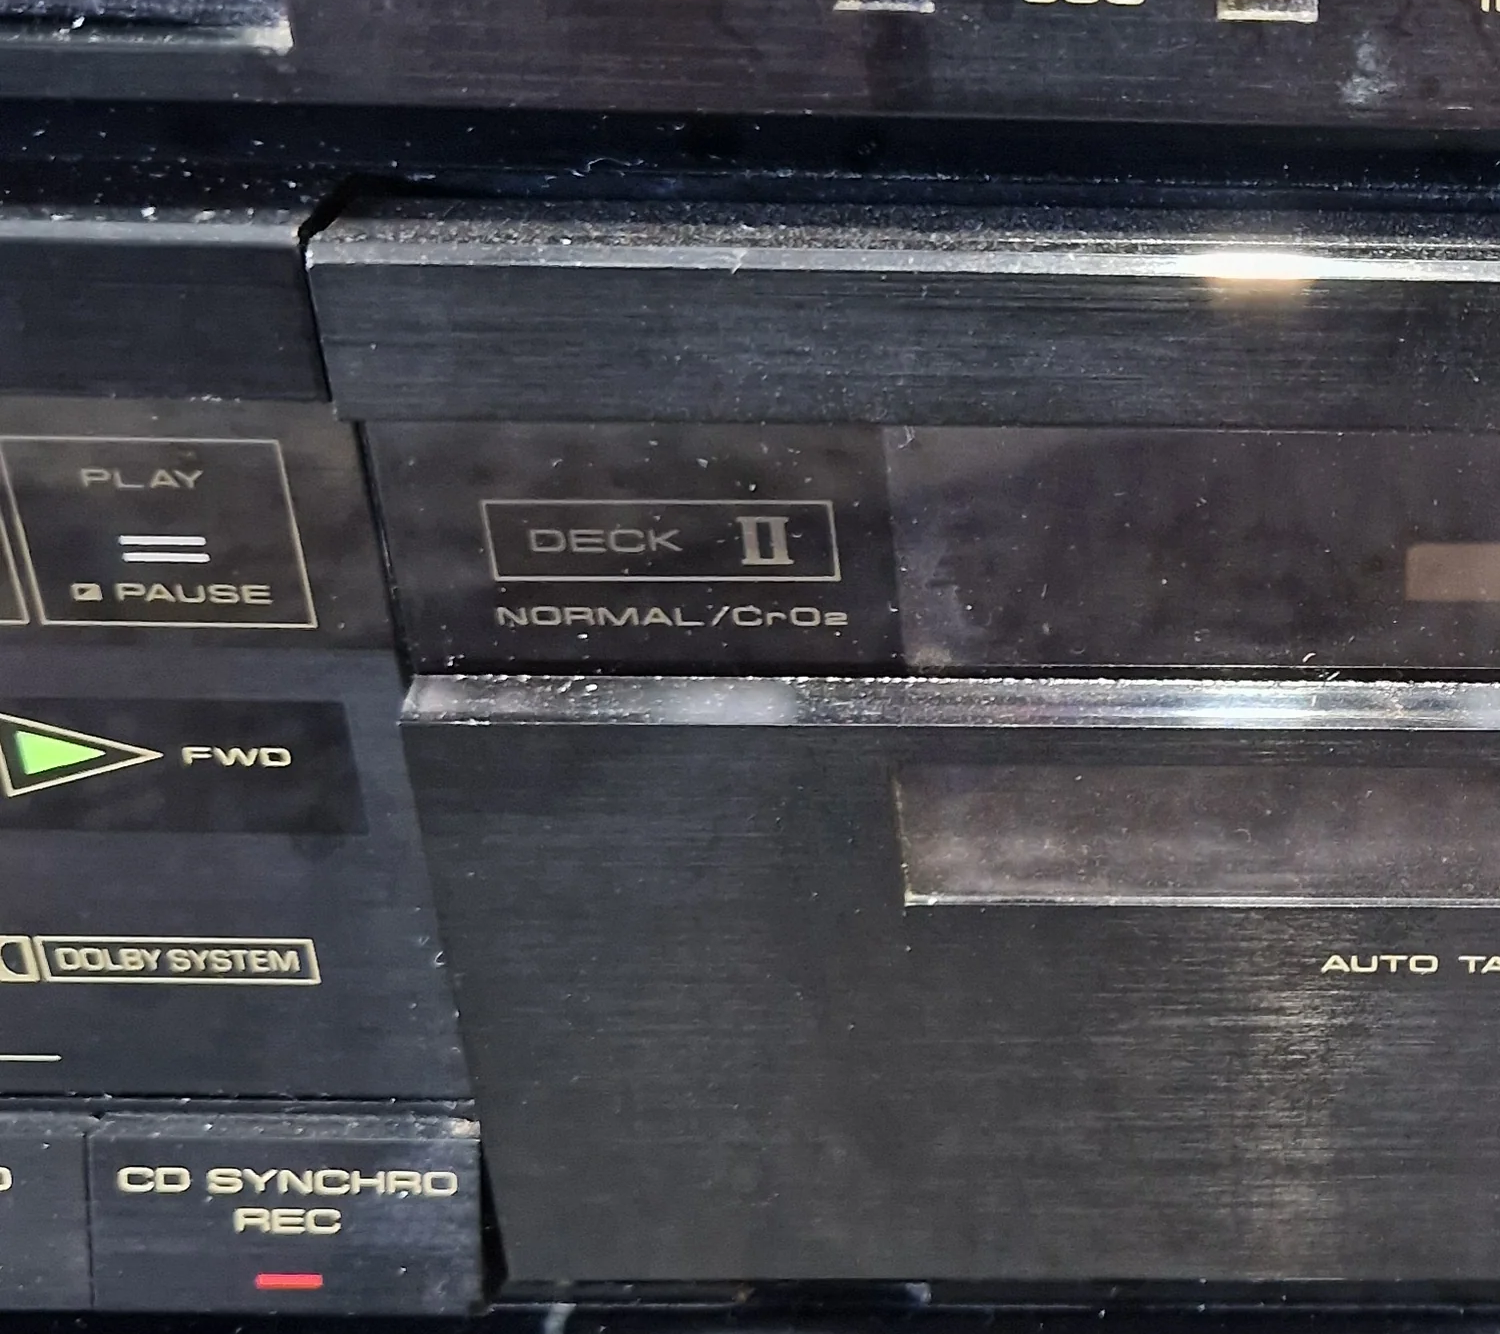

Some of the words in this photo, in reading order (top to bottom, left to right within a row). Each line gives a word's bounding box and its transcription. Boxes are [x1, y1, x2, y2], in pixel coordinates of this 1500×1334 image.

[80, 467, 204, 489] PLAY
[528, 528, 683, 553] DECK
[735, 515, 795, 566] II
[115, 582, 273, 605] PAUSE
[181, 746, 292, 767] FWD
[54, 947, 162, 971] DOLBY
[165, 948, 300, 973] SYSTEM
[1320, 954, 1439, 975] AUTO
[117, 1166, 191, 1193] CD
[206, 1168, 458, 1196] SYNCHRO
[234, 1207, 342, 1234] REC
